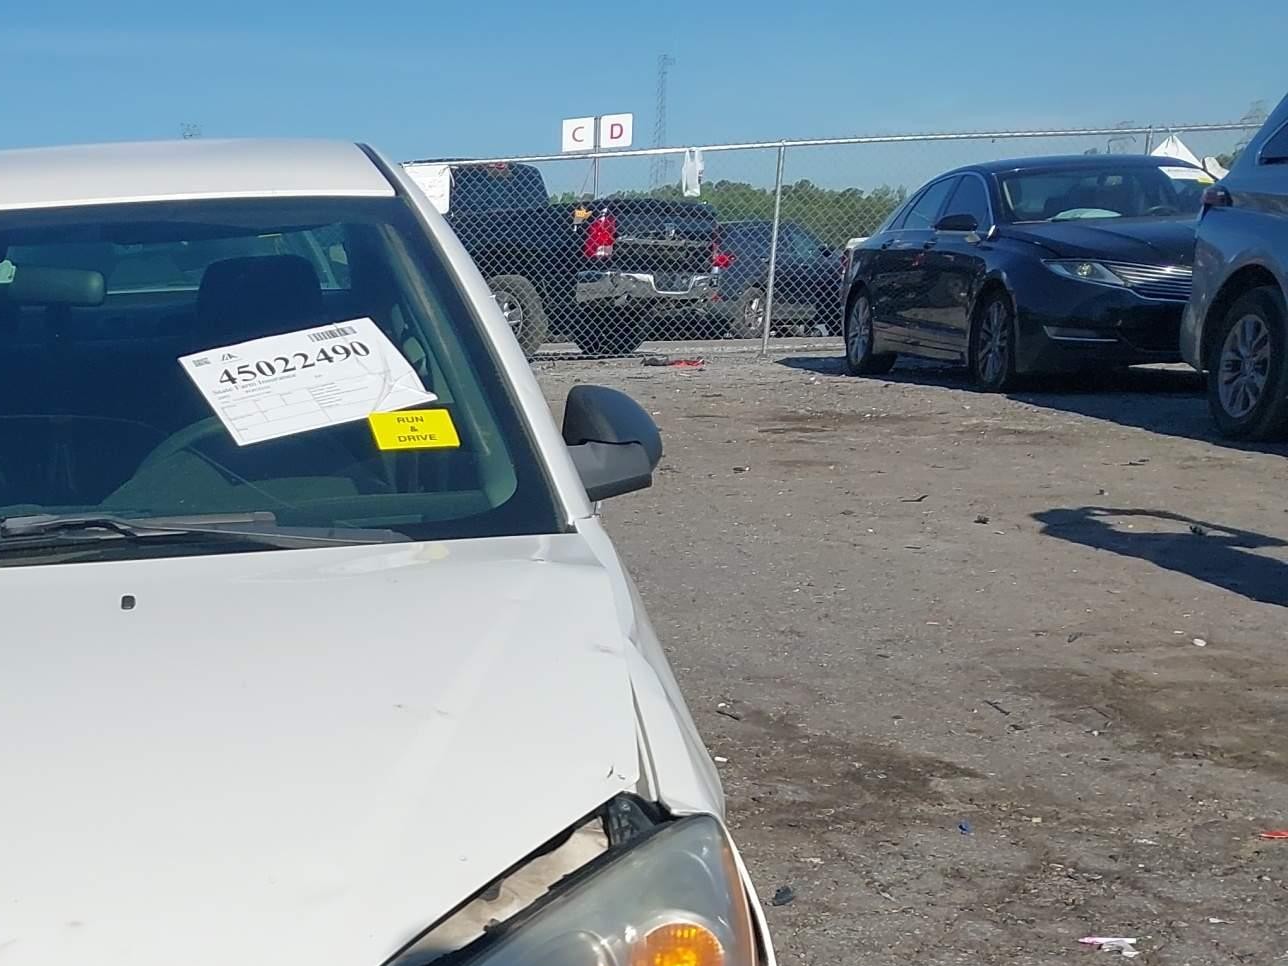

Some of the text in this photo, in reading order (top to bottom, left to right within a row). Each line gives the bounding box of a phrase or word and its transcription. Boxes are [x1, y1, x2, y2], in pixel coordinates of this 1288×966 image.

[572, 126, 585, 142] C
[610, 123, 623, 139] D
[219, 341, 370, 385] 45022490
[396, 416, 424, 424] RUN
[397, 434, 438, 443] DRIVE
